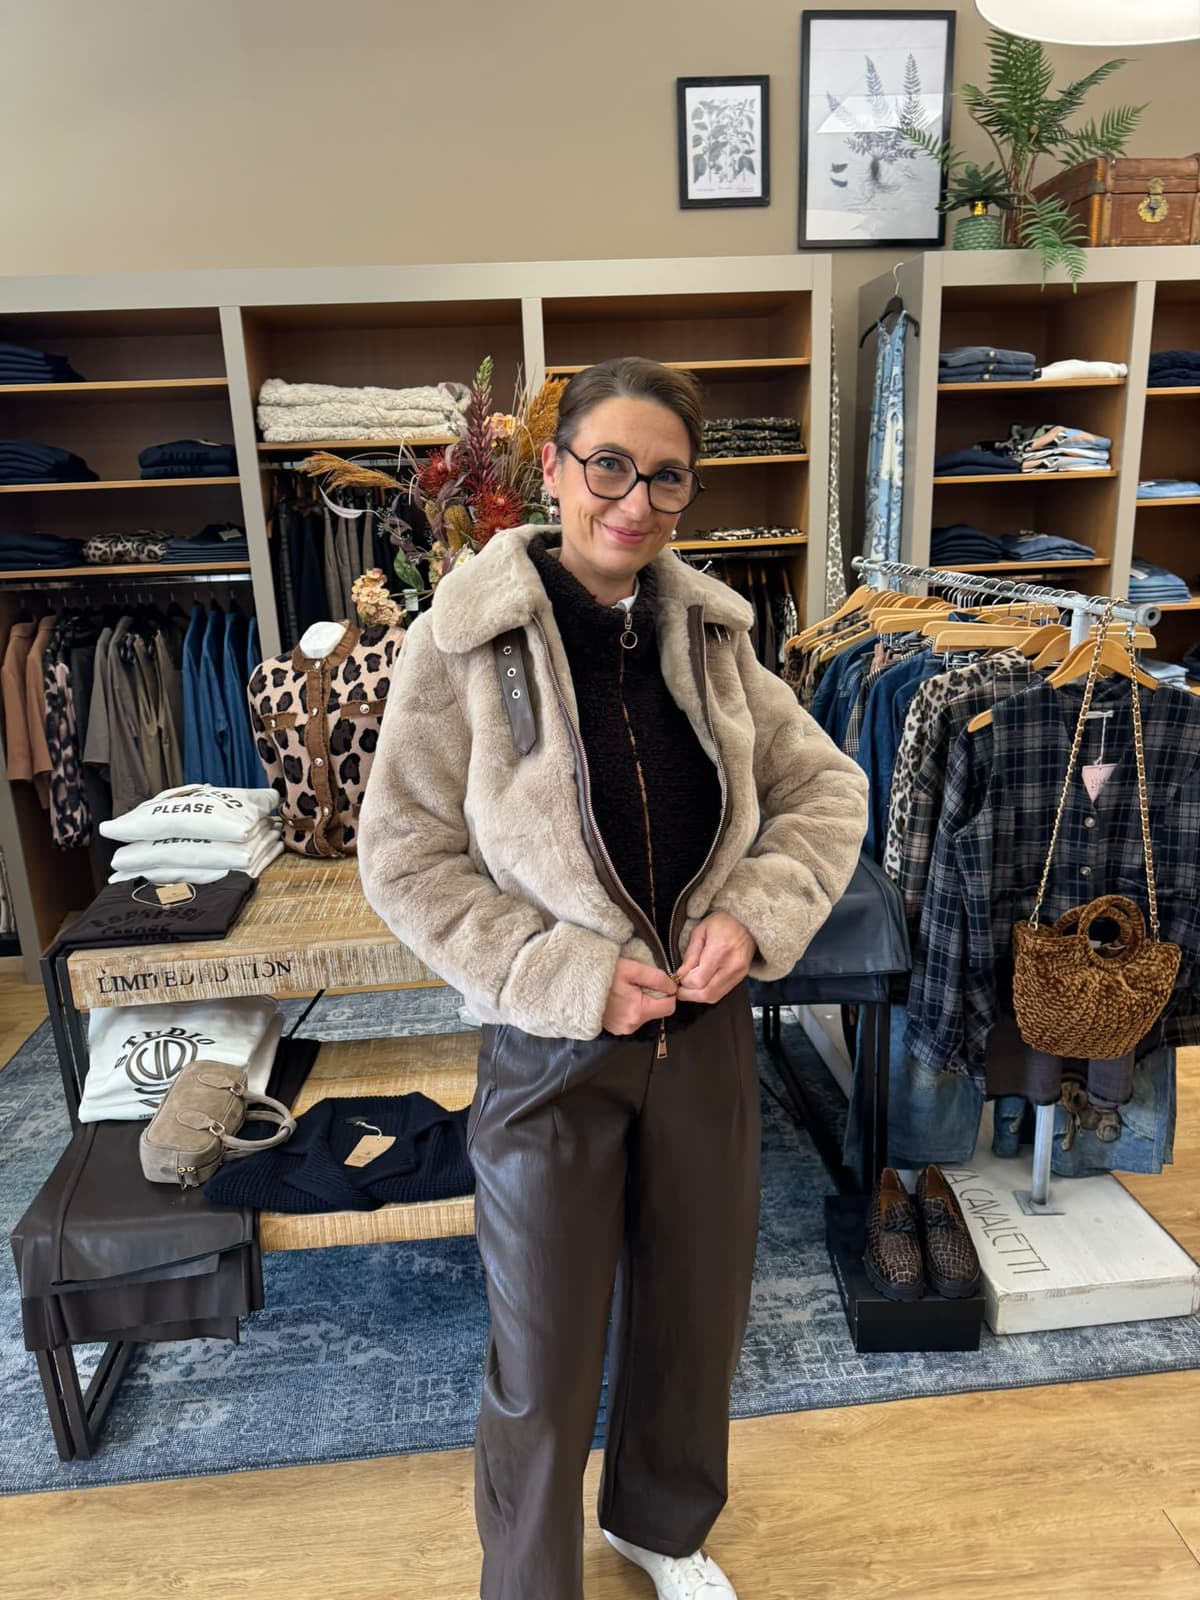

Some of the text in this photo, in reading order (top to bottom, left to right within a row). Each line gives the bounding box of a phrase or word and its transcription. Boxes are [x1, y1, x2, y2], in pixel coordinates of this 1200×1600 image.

[151, 803, 215, 815] PLEASE
[198, 959, 292, 985] EDTION
[114, 1026, 217, 1070] STUDIO
[959, 1188, 1051, 1275] CAVALETTI
